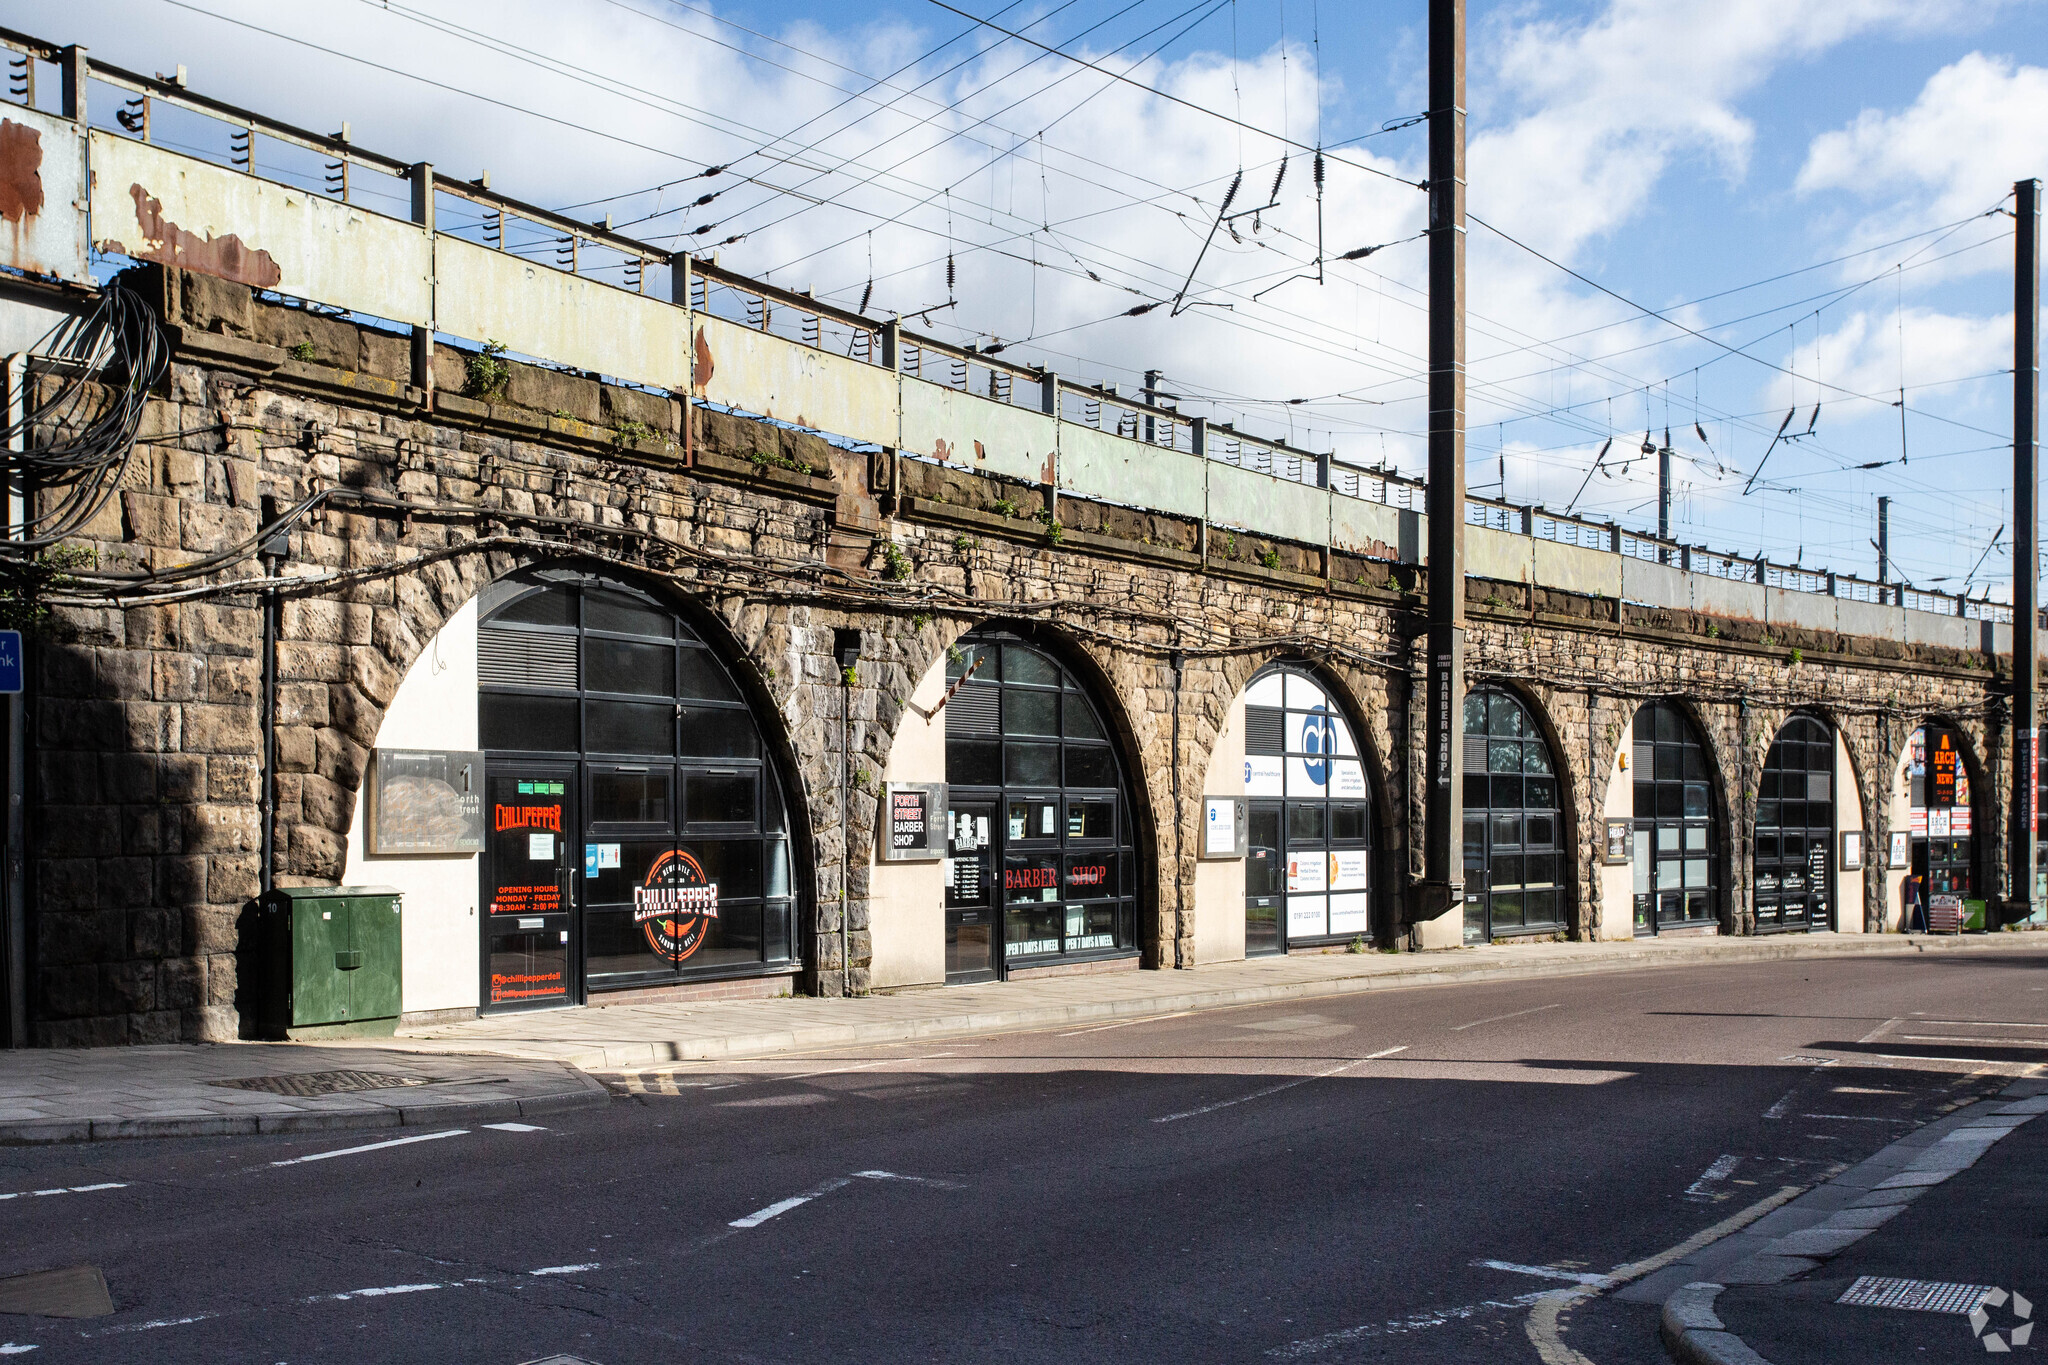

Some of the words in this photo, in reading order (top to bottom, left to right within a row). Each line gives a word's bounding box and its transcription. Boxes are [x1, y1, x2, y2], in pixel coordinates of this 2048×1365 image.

[1440, 671, 1449, 730] BARBER
[1440, 732, 1449, 772] SHOP
[1934, 751, 1955, 764] ARCH
[460, 763, 472, 791] 1
[1936, 773, 1954, 785] NEWS
[894, 794, 919, 807] FORTH
[495, 803, 561, 832] CHILLIPEPPER
[894, 807, 922, 820] STREET
[894, 821, 924, 833] BARBER
[1931, 817, 1947, 827] ARCH
[1609, 827, 1625, 839] HEAD
[894, 834, 914, 846] SHOP
[955, 835, 978, 851] BARBER
[1005, 867, 1058, 889] BARBER
[1072, 865, 1107, 886] SHOP
[498, 886, 532, 894] OPENING
[533, 885, 559, 893] HOURS
[495, 895, 528, 903] MONDAY
[534, 893, 561, 901] FRIDAY
[635, 883, 718, 922] CHILLIPEPPER
[547, 902, 559, 910] PM
[1019, 942, 1023, 954] 7
[1023, 940, 1038, 954] DAYS
[1038, 940, 1042, 953] A
[1042, 939, 1059, 952] WEEK
[1077, 937, 1081, 949] 7
[1081, 936, 1094, 948] DAYS
[1094, 935, 1099, 947] A
[1098, 934, 1114, 947] WEEK
